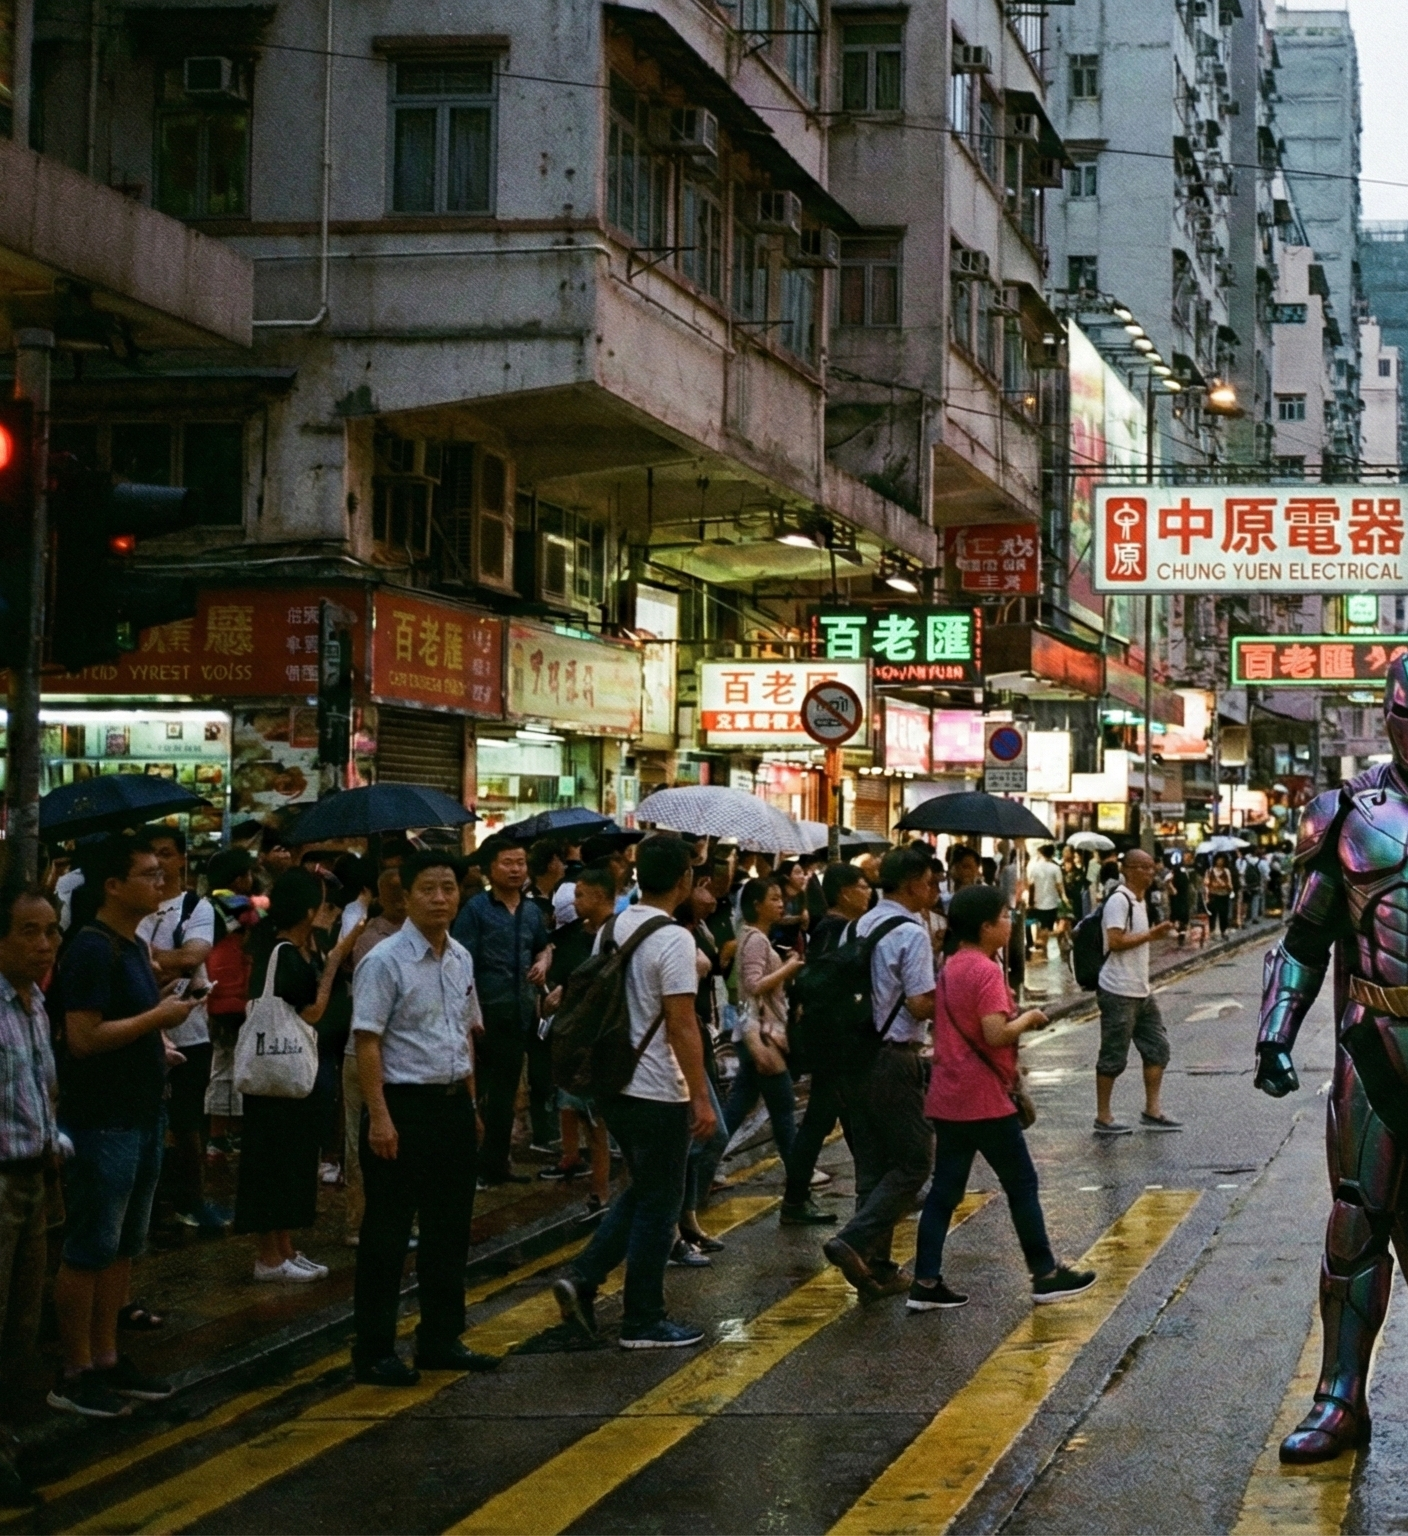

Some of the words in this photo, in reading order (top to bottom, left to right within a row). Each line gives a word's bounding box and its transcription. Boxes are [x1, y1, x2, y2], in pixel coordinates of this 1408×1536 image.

[1158, 497, 1404, 556] 中原電器
[1157, 562, 1226, 580] CHUNG
[1232, 563, 1282, 580] YUEN
[1289, 562, 1403, 580] ELECTRICAL
[819, 614, 972, 662] 百老匯
[1240, 643, 1355, 679] 百老匯
